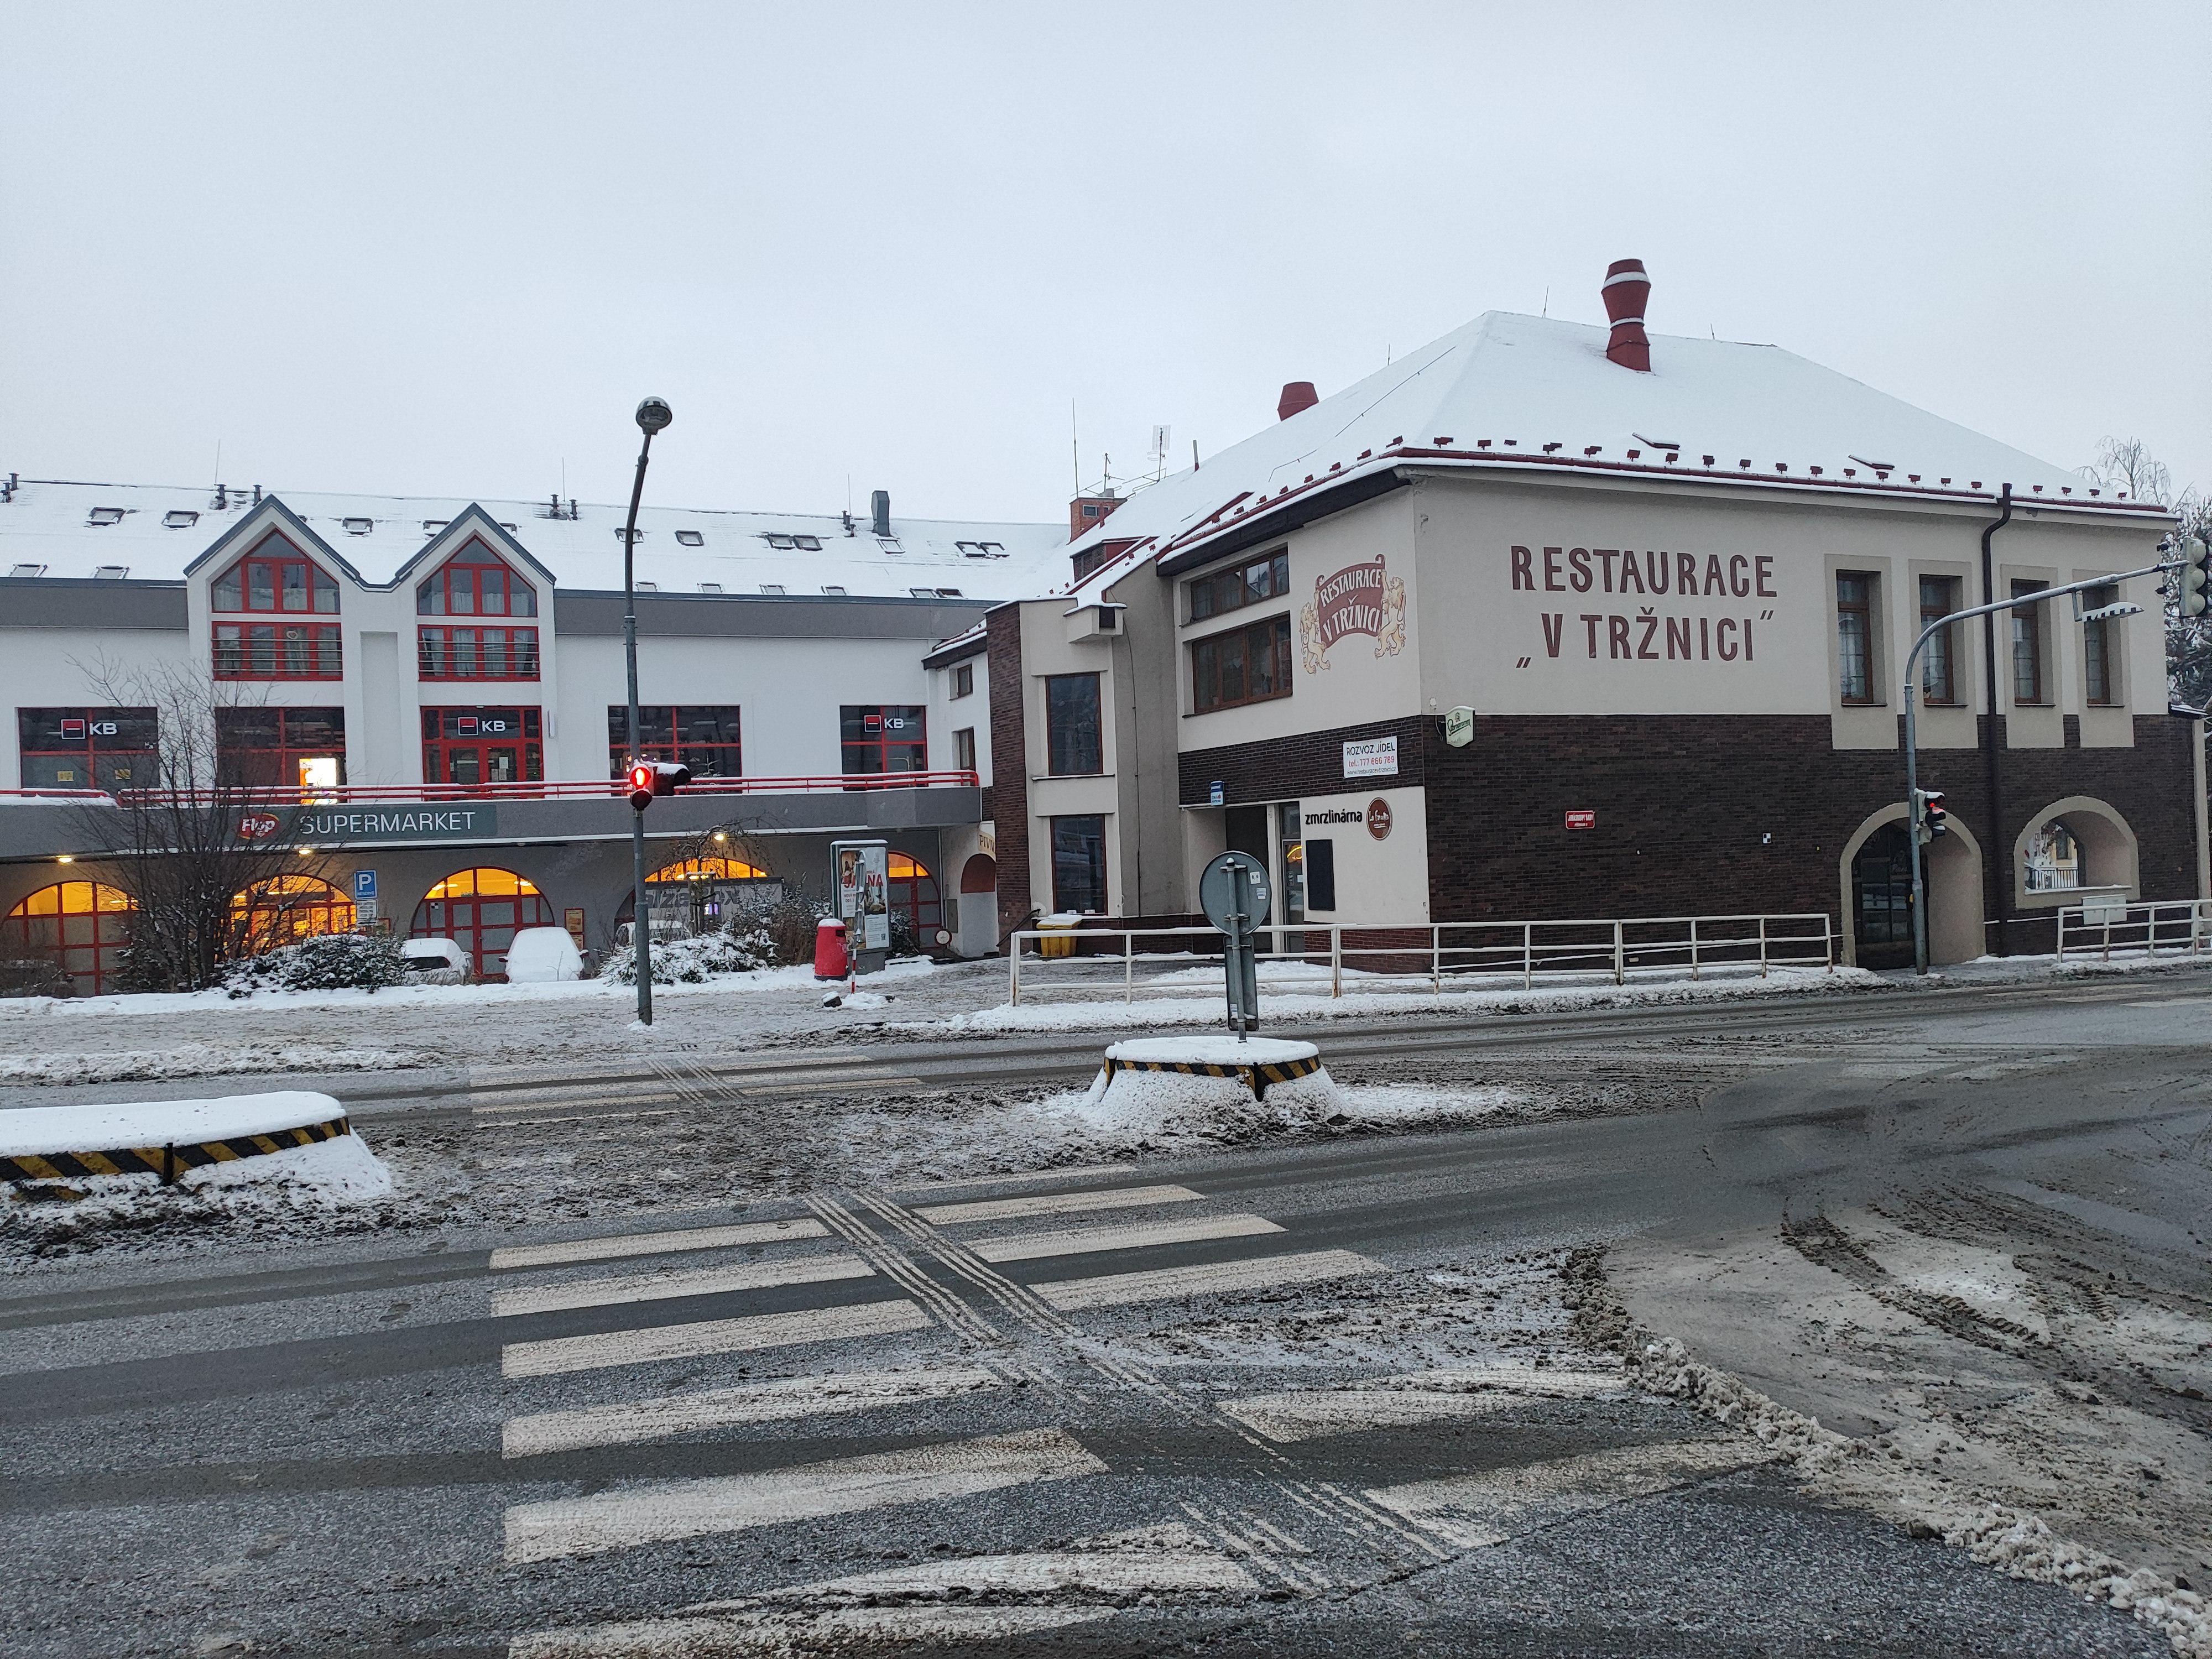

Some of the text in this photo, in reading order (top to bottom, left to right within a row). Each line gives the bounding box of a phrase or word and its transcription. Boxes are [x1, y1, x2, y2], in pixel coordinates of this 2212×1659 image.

[1511, 545, 1777, 598] RESTAURACE
[1319, 568, 1382, 608] RESTAURACE
[1323, 594, 1381, 641] V TRŽNICI
[89, 723, 118, 735] KB
[482, 721, 506, 732] KB
[884, 718, 904, 729] KB
[1346, 741, 1396, 756] ROZVOZ JÍDEL
[1360, 758, 1370, 766] 777
[1371, 757, 1383, 765] 666
[1384, 755, 1395, 764] 789
[299, 811, 476, 834] SUPERMARKET
[1305, 808, 1363, 825] zmrzlinárna
[358, 874, 372, 890] P
